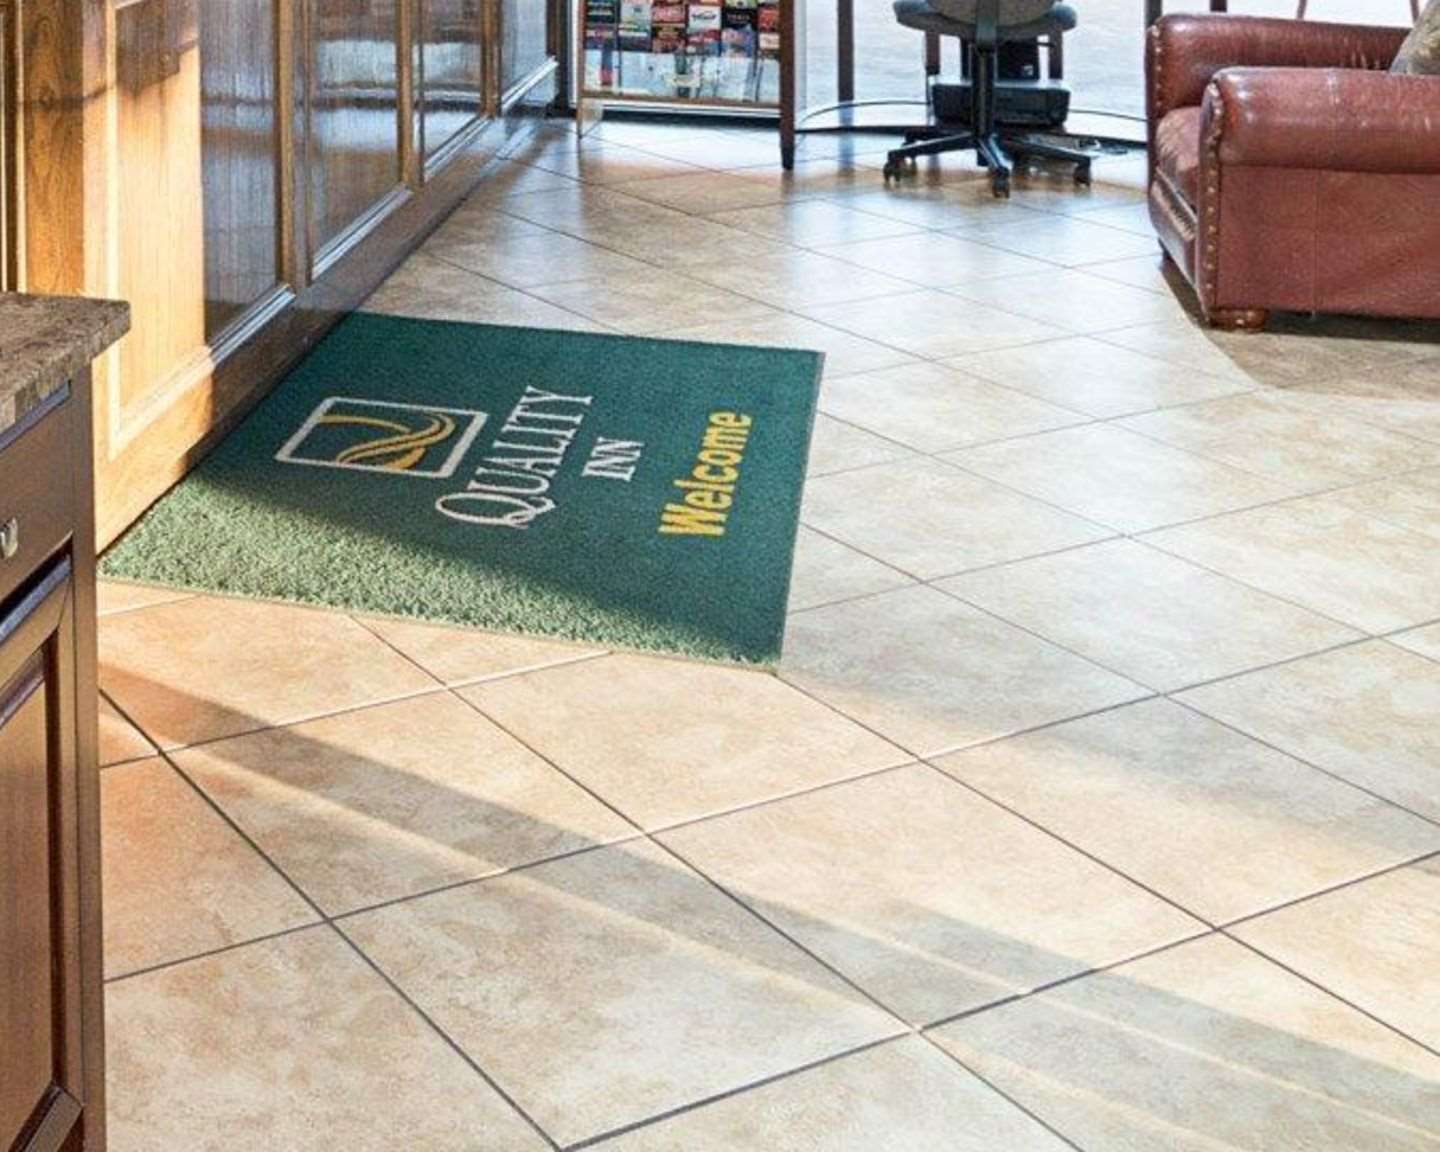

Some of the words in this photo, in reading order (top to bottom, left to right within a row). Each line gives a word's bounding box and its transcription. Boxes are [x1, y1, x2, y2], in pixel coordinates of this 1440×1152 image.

[435, 385, 594, 529] QUALITY
[581, 436, 644, 481] INN
[658, 411, 752, 536] Welcome
